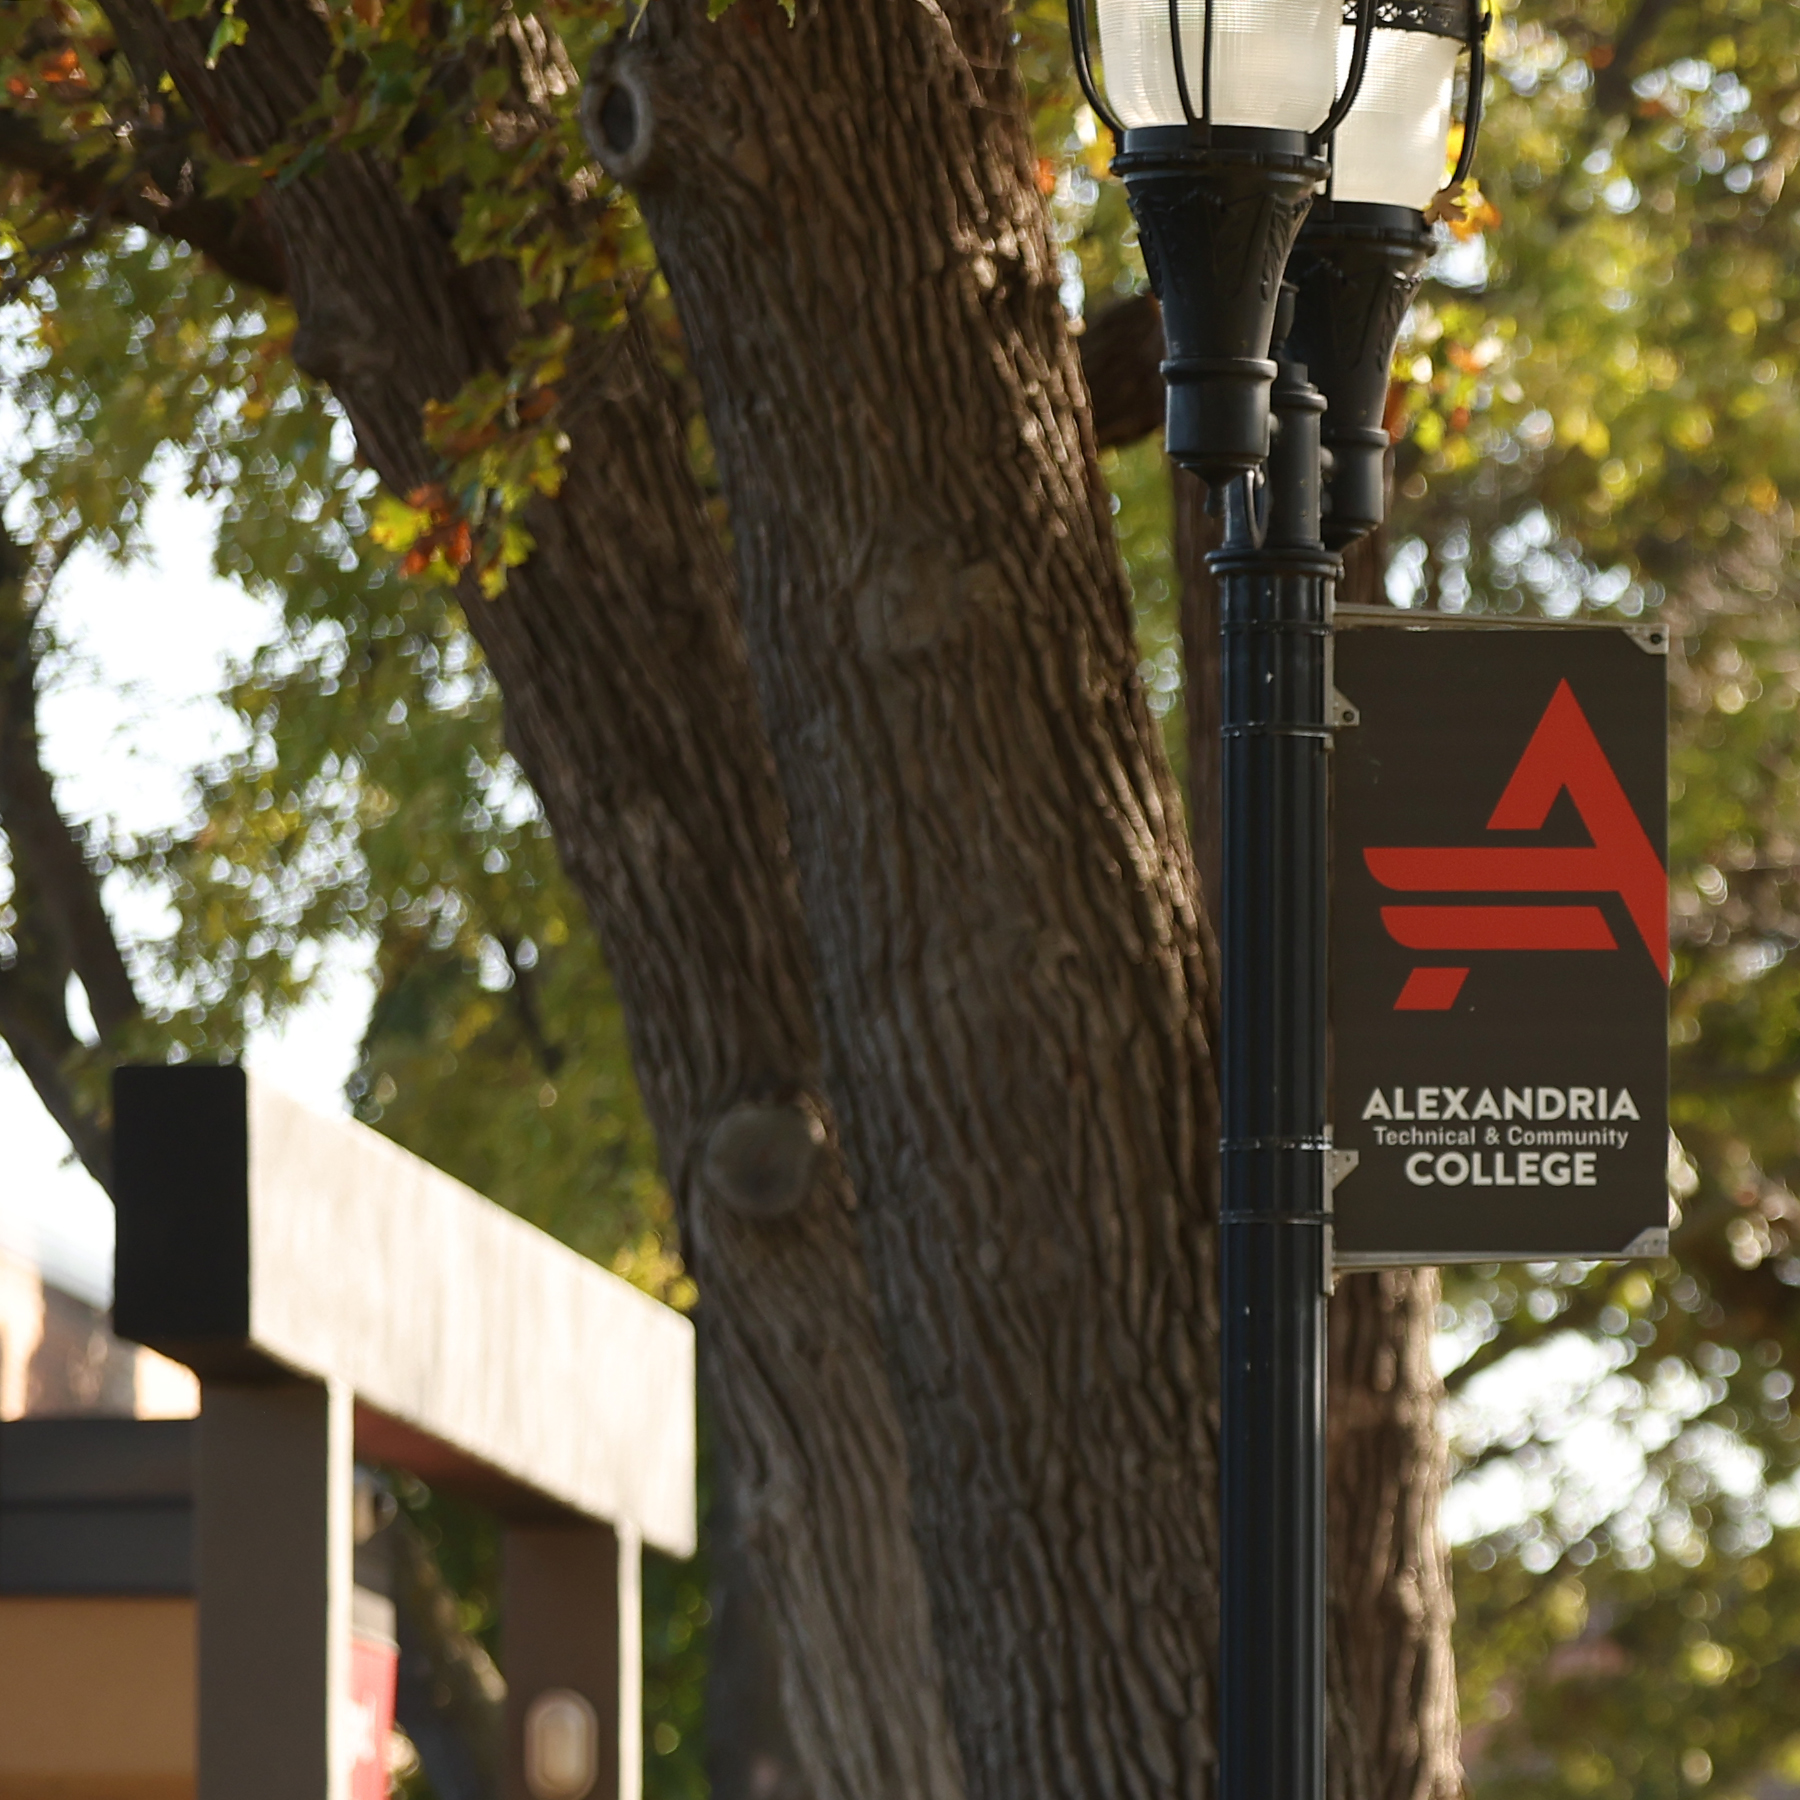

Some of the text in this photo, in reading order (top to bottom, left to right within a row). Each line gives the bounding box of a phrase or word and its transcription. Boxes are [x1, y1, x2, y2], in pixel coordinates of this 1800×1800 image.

[1361, 1086, 1641, 1121] ALEXANDRIA
[1373, 1126, 1629, 1149] Technical & Community
[1405, 1152, 1598, 1187] COLLEGE
